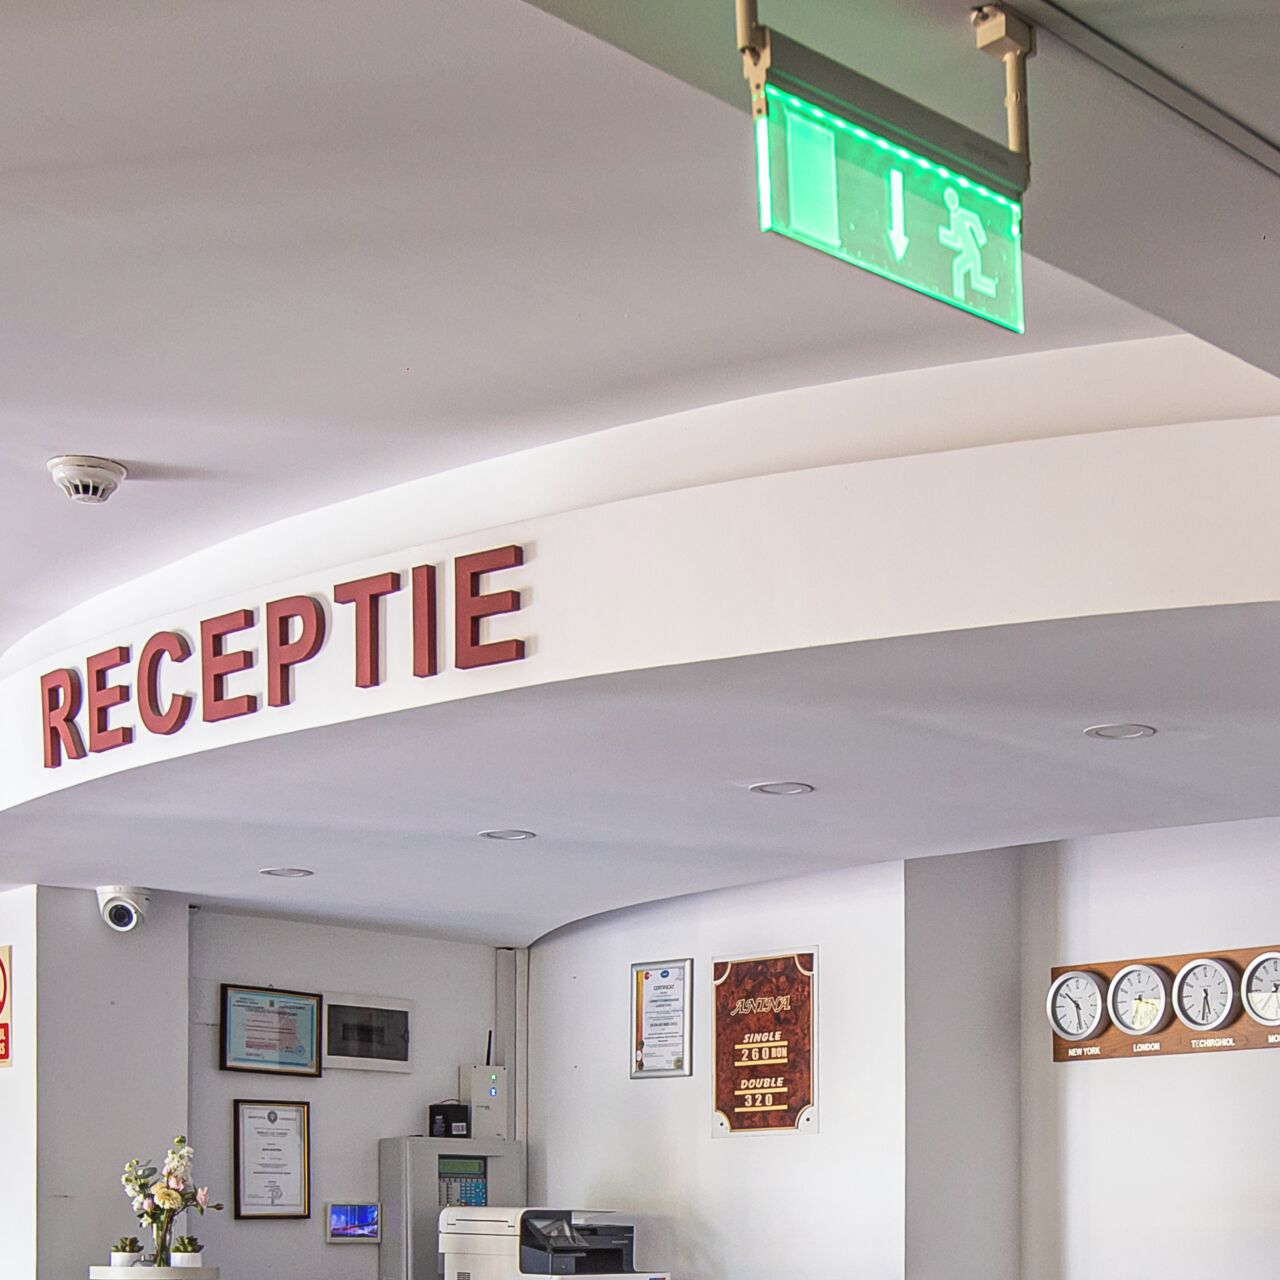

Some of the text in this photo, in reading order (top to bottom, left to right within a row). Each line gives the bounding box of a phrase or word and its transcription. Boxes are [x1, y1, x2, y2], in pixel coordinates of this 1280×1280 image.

[41, 544, 524, 769] RECEPTIE
[730, 995, 791, 1017] ANINA
[743, 1031, 782, 1043] SINGLE
[1191, 1037, 1235, 1048] TECHIRGHIOL
[1068, 1046, 1101, 1057] NEW YORK
[1133, 1042, 1161, 1052] LONDON
[741, 1047, 788, 1061] 260 RON
[740, 1077, 785, 1089] DOUBLE
[744, 1094, 773, 1107] 320
